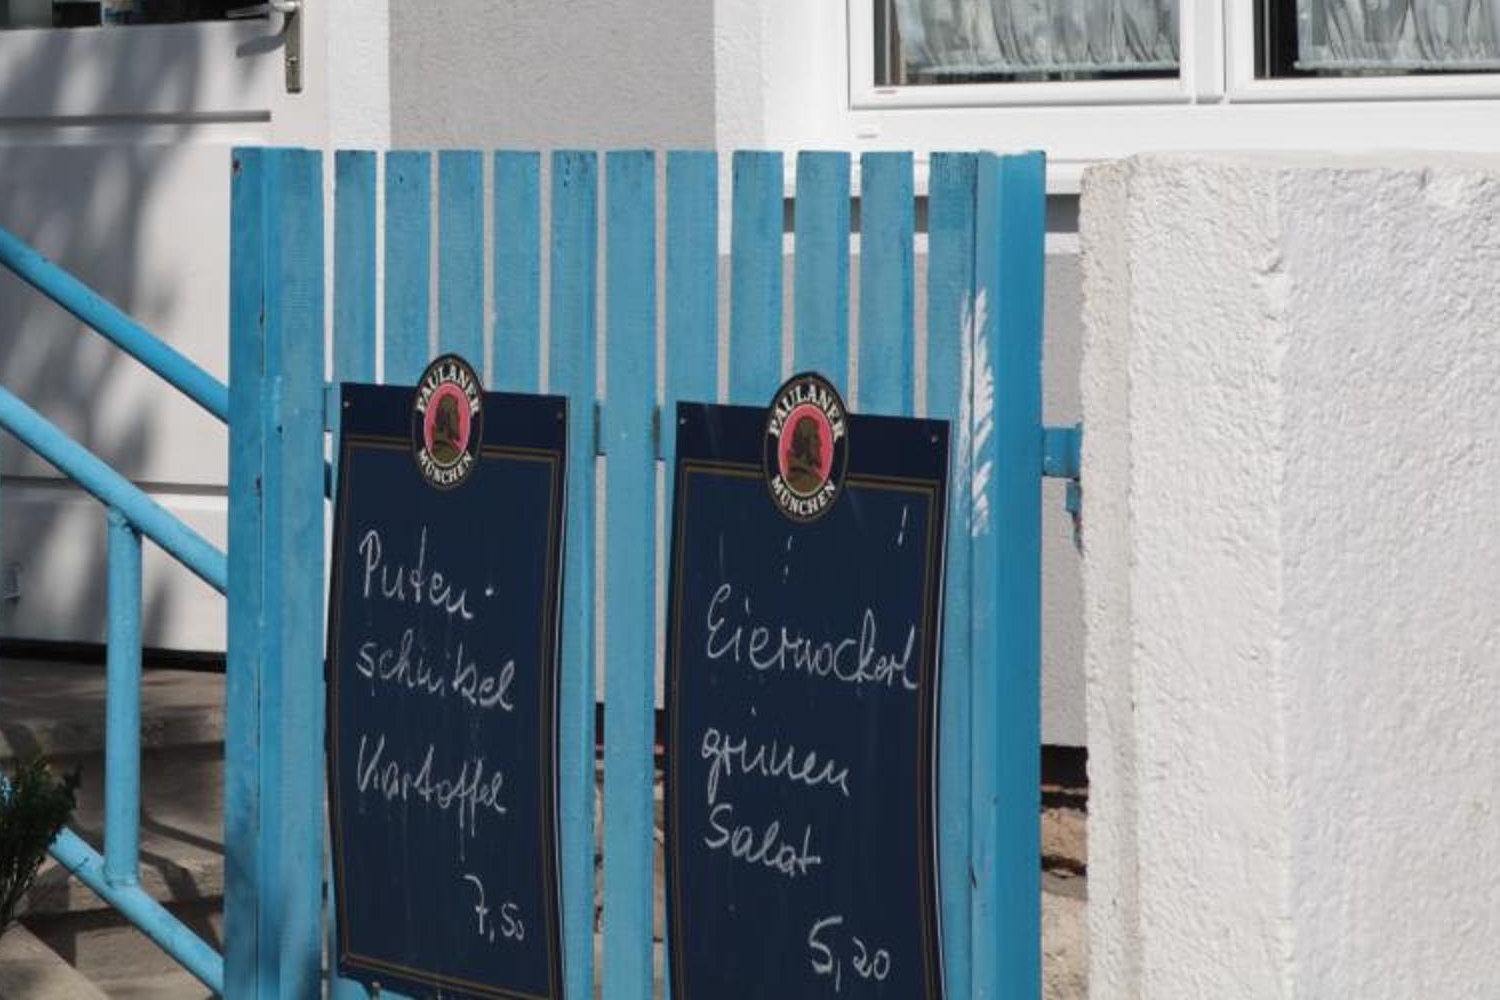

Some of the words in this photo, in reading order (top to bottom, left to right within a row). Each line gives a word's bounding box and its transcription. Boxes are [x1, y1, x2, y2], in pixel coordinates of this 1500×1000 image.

[417, 364, 481, 417] PAULANER
[769, 384, 845, 442] PAULANER
[705, 803, 822, 877] Salat
[808, 915, 891, 993] 5,20
